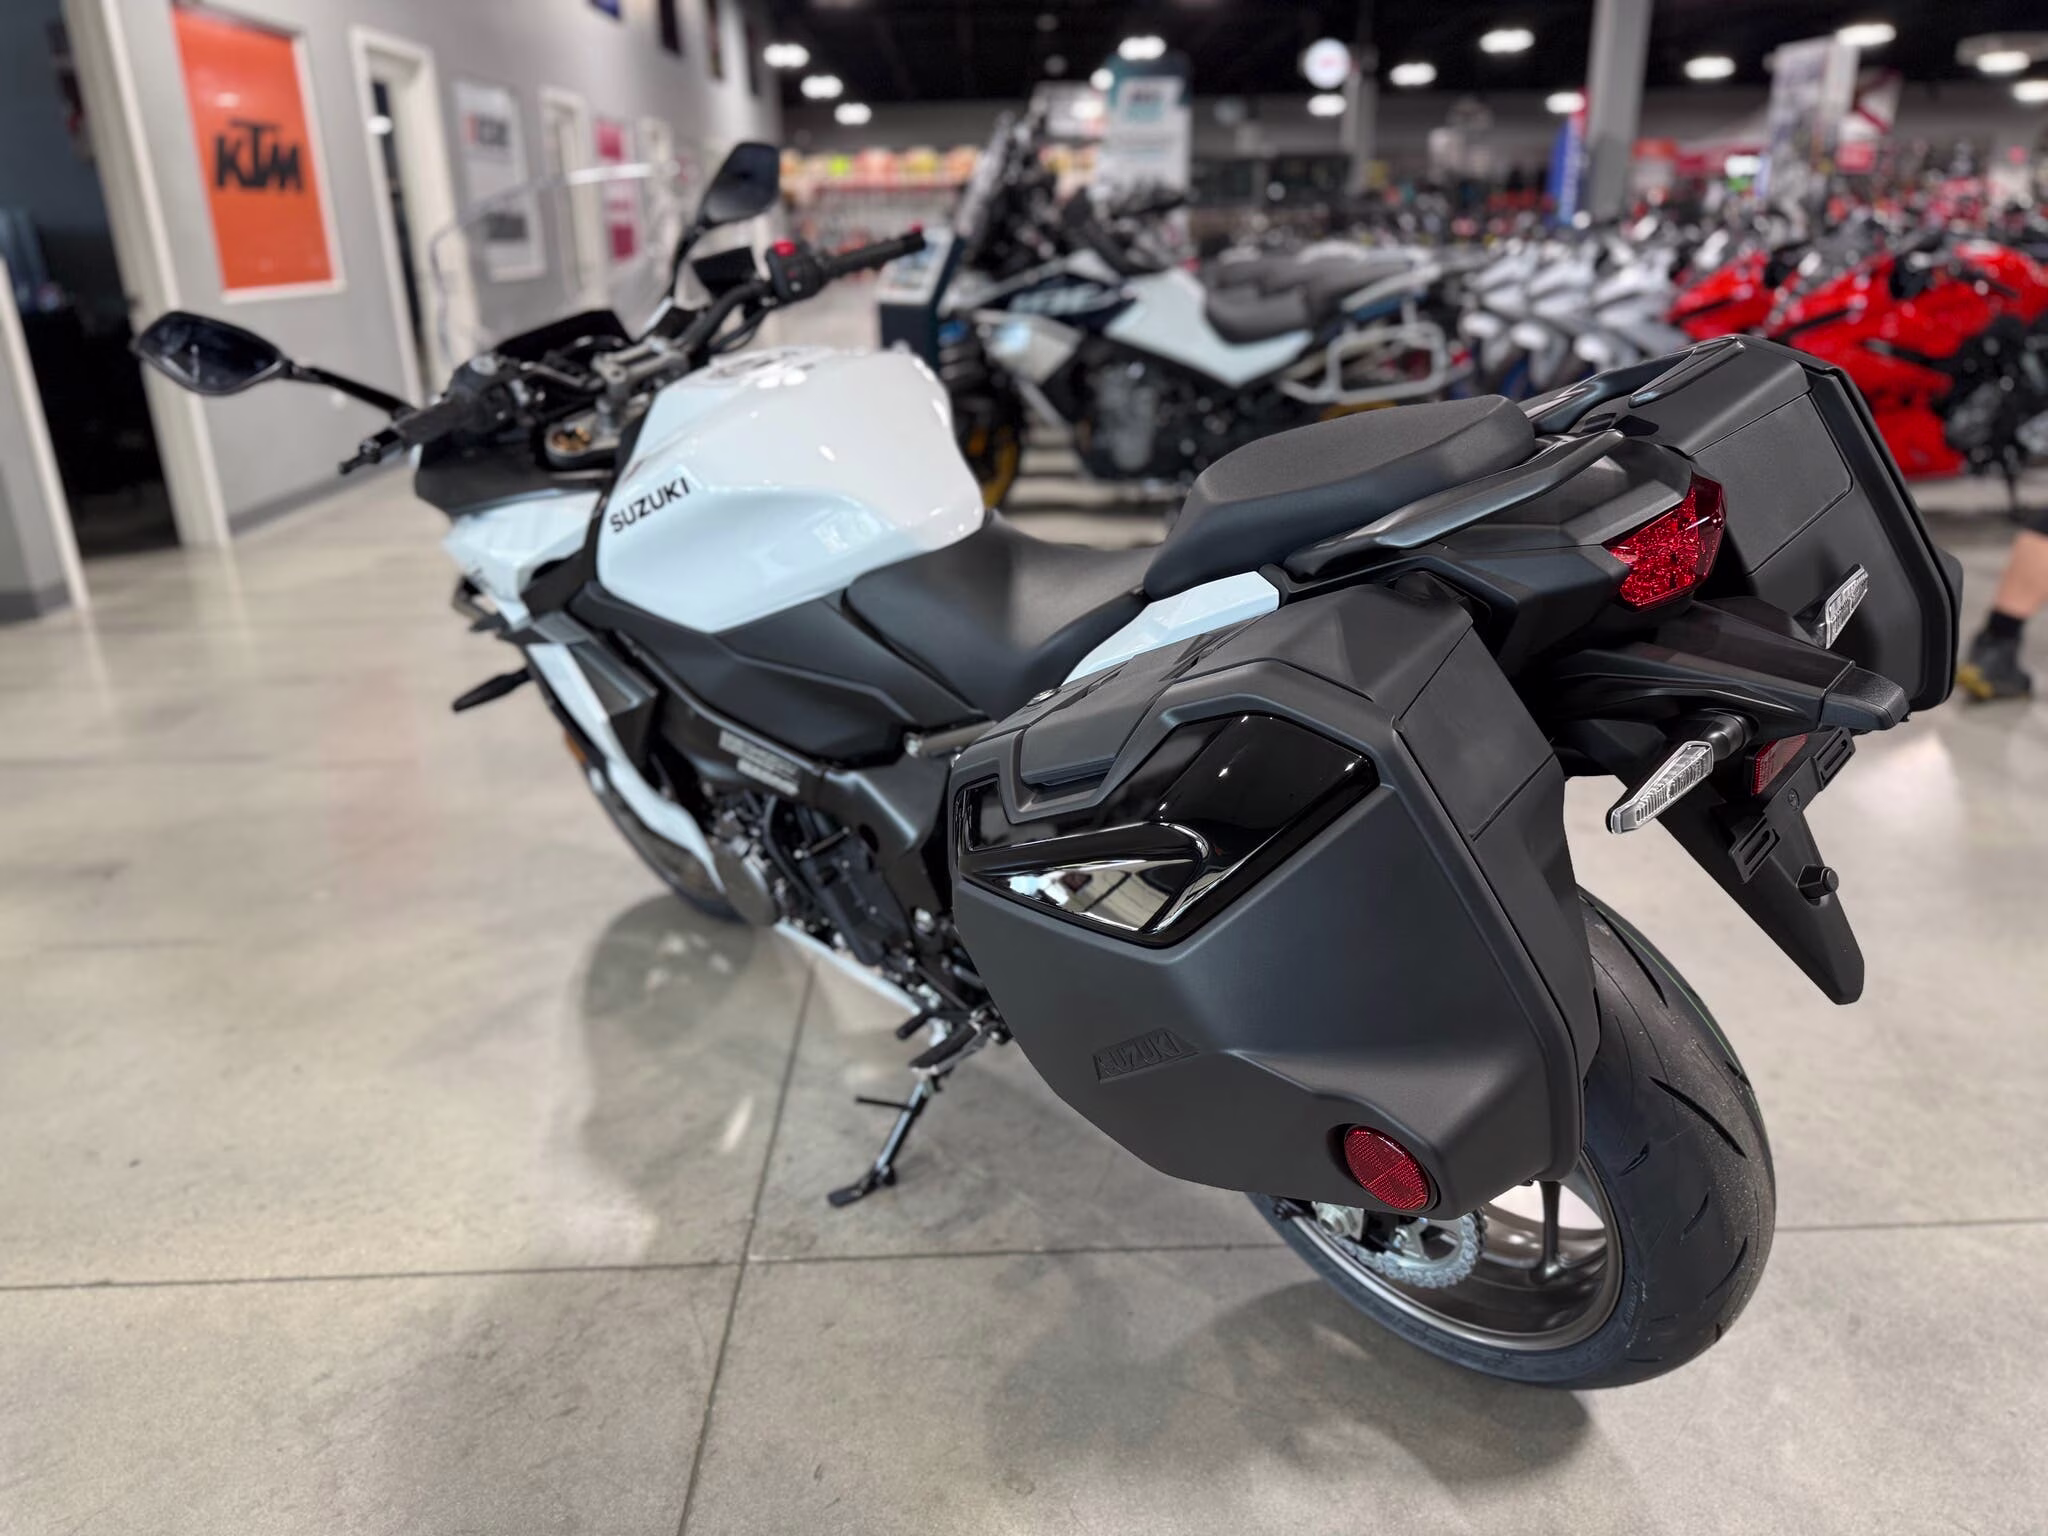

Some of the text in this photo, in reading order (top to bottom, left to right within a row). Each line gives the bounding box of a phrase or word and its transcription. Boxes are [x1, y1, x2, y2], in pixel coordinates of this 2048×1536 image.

[214, 118, 303, 193] KTM
[609, 477, 690, 533] SUZUKI
[1098, 1030, 1181, 1077] SUZUKI
